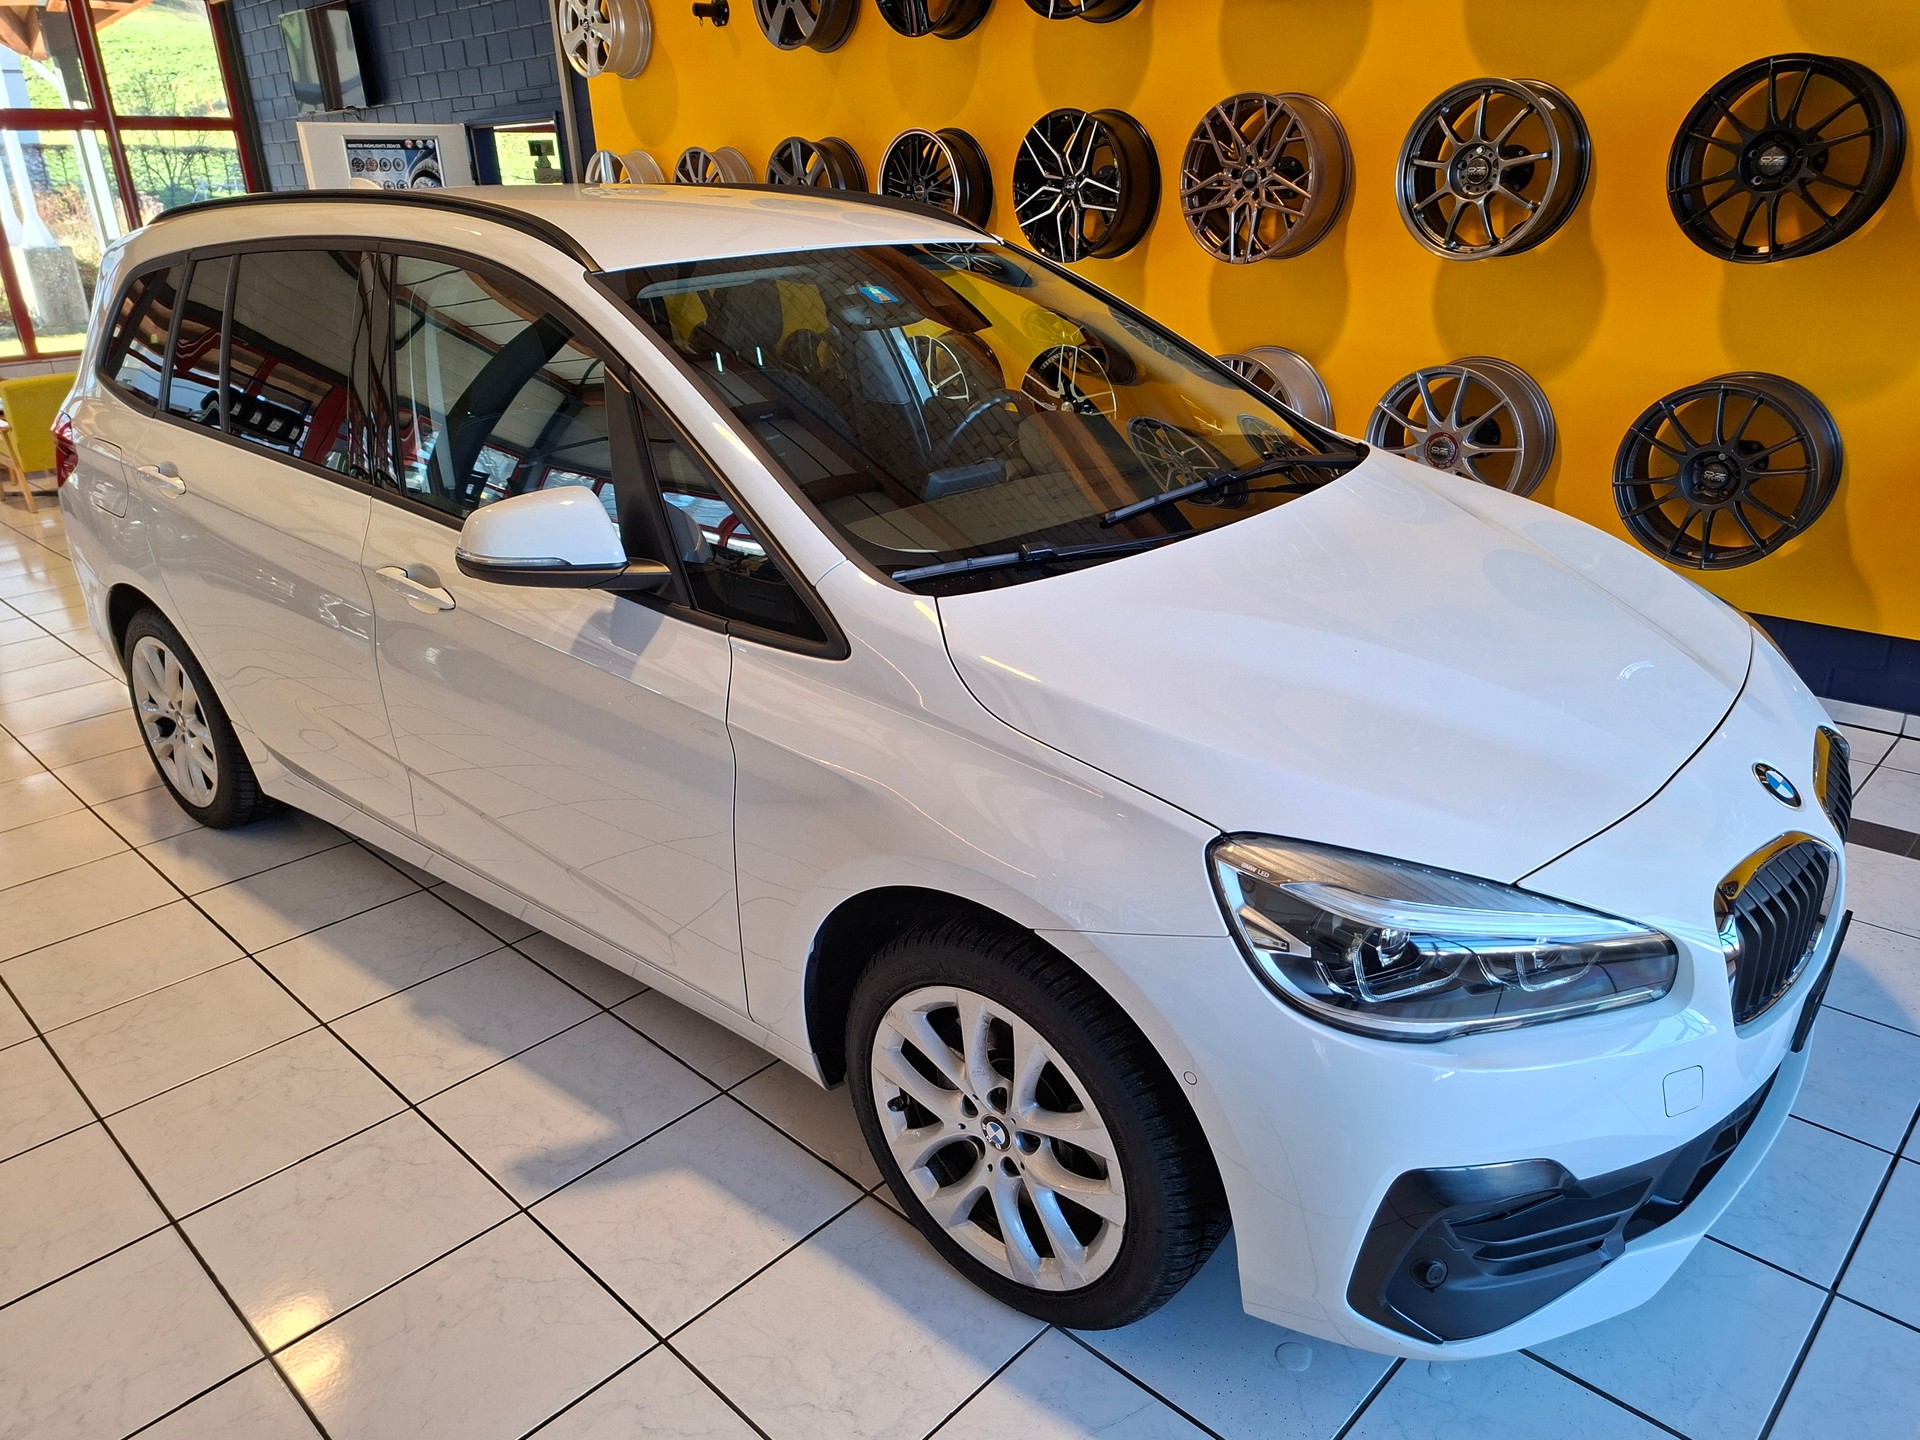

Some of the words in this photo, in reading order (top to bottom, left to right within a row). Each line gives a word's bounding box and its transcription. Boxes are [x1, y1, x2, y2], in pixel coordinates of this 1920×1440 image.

[1704, 470, 1726, 478] OZ
[1241, 862, 1257, 872] BMW
[1257, 869, 1270, 878] LED
